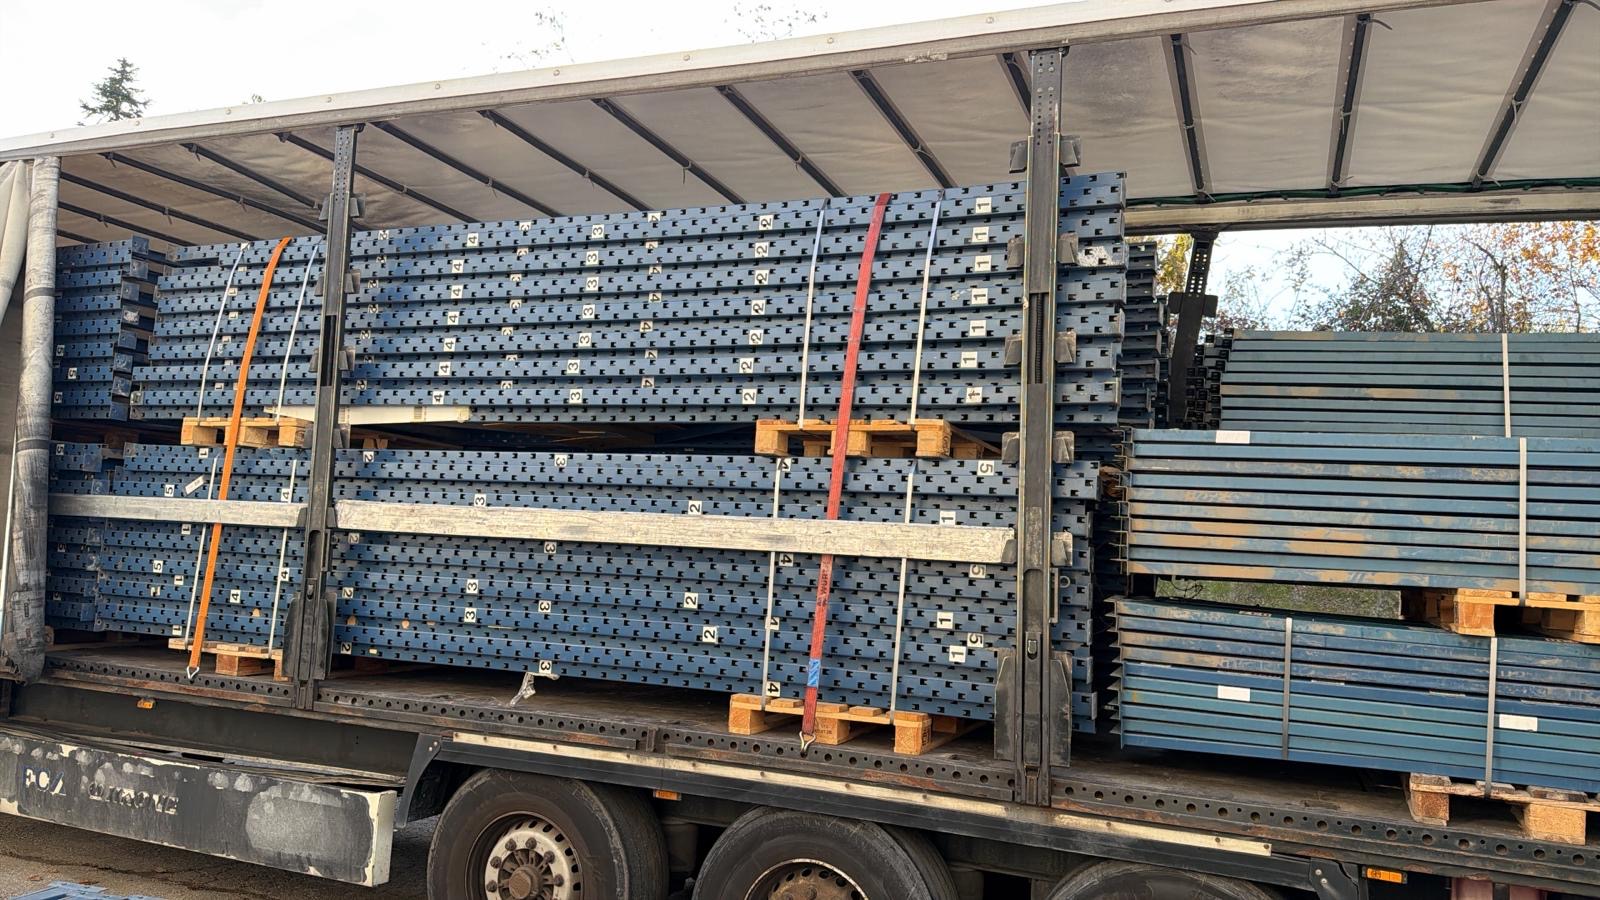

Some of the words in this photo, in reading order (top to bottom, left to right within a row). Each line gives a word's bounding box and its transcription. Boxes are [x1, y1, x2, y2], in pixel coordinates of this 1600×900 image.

[979, 462, 994, 474] 5
[780, 554, 793, 565] 4
[971, 564, 985, 575] 5
[969, 633, 983, 644] 5
[767, 682, 780, 693] 4
